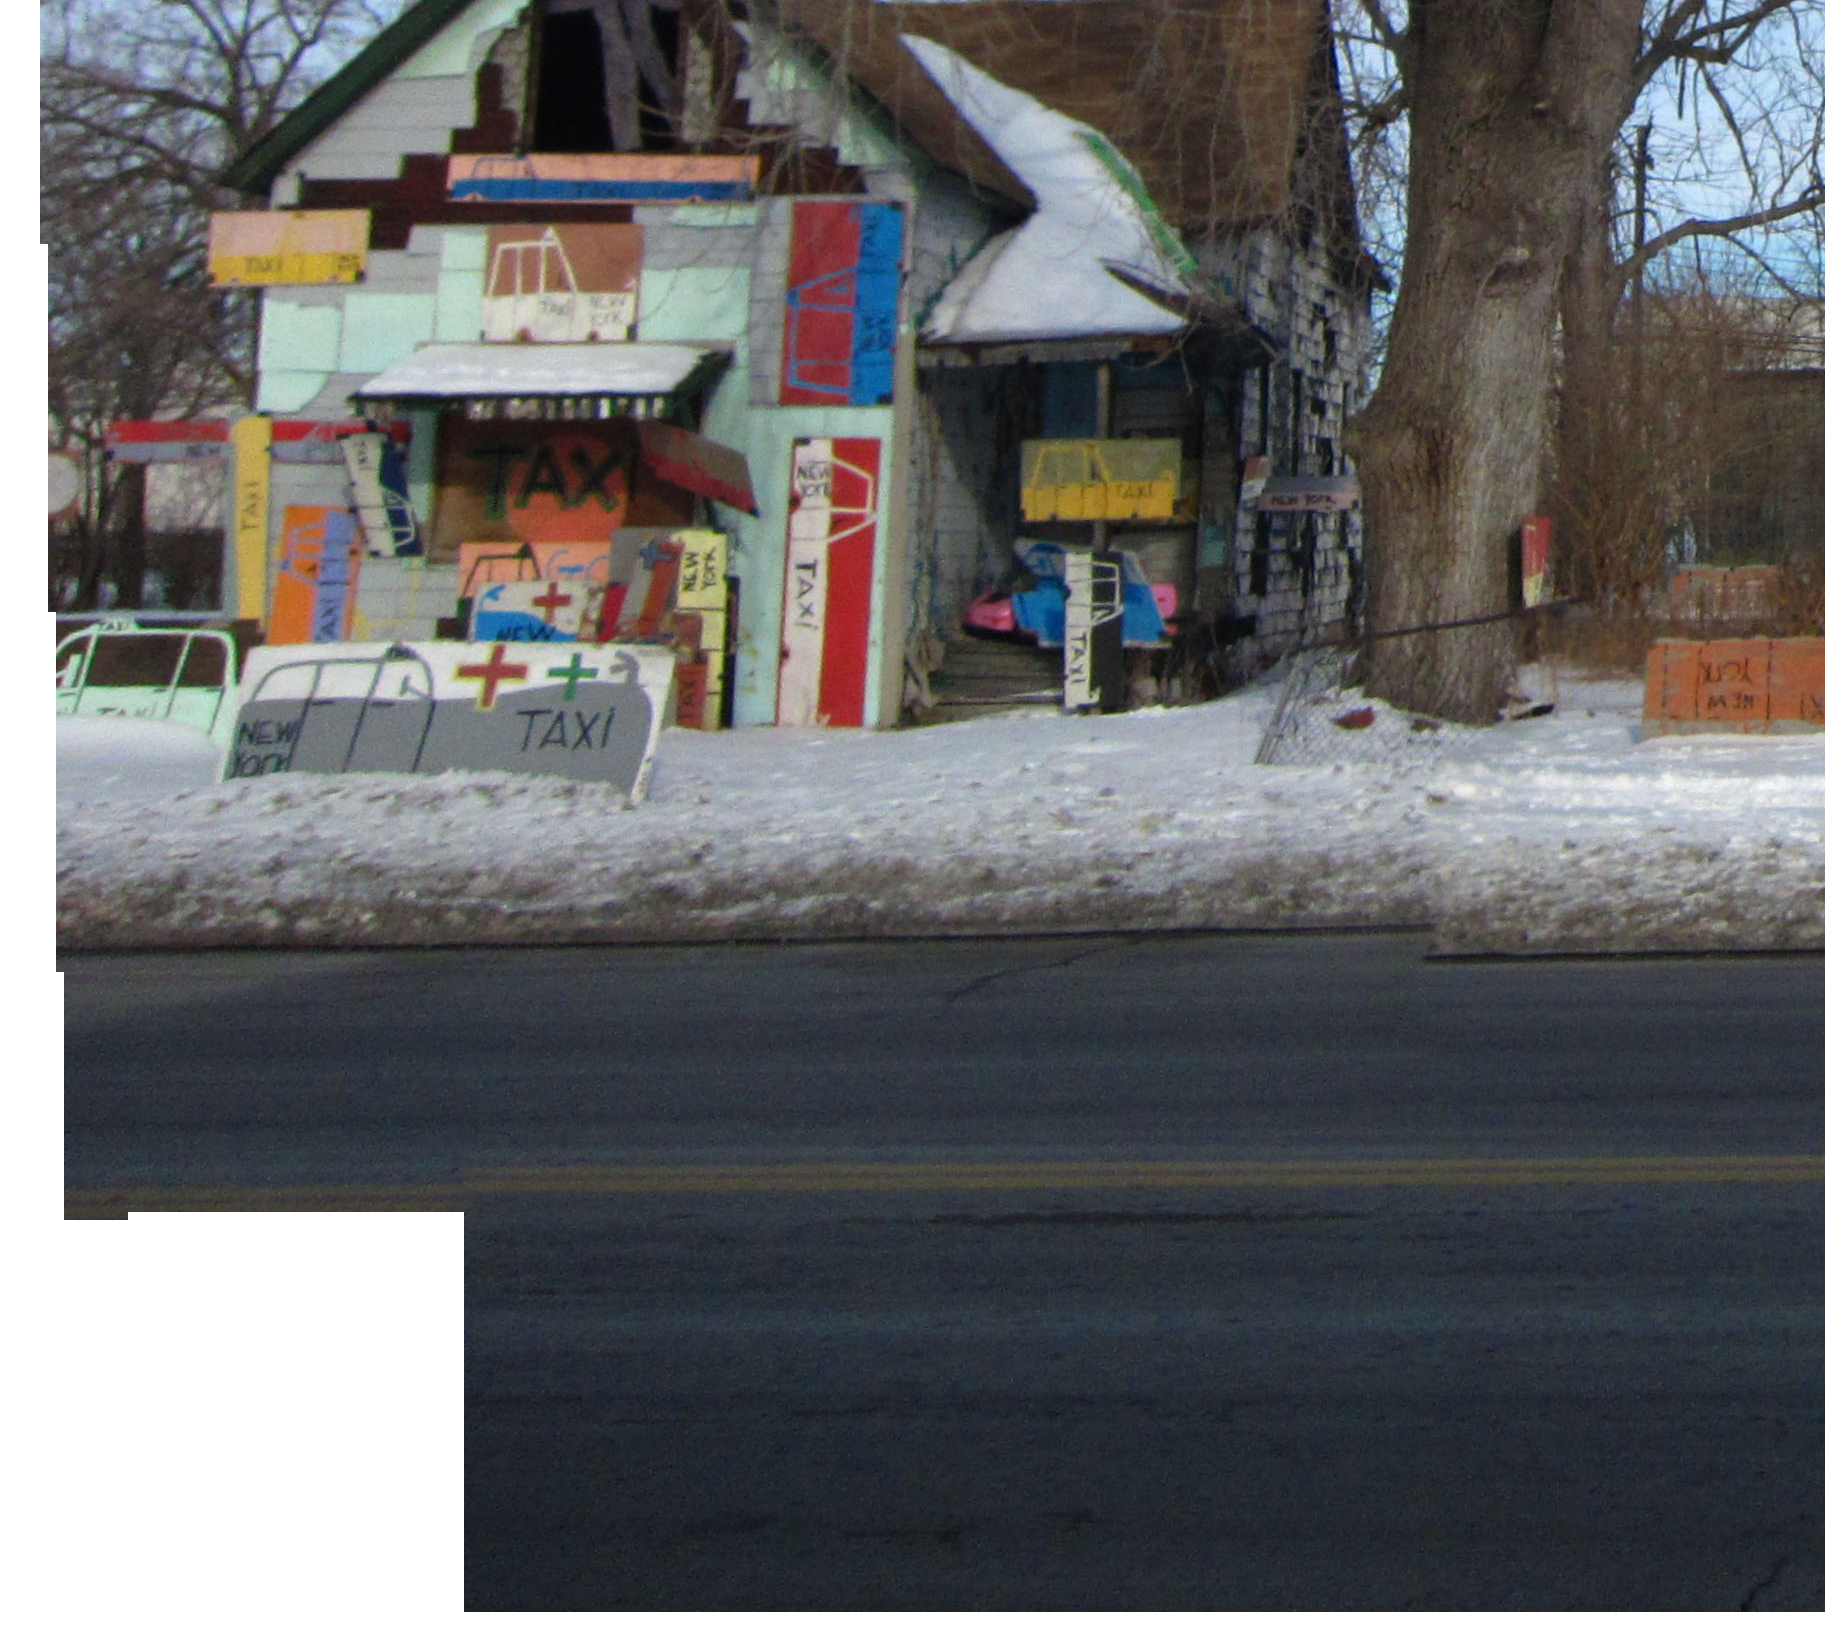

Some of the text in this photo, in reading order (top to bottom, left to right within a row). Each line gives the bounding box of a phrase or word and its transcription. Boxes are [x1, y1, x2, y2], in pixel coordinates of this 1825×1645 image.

[496, 619, 556, 641] NEW
[1069, 630, 1087, 684] TAXI
[240, 718, 300, 744] NEW
